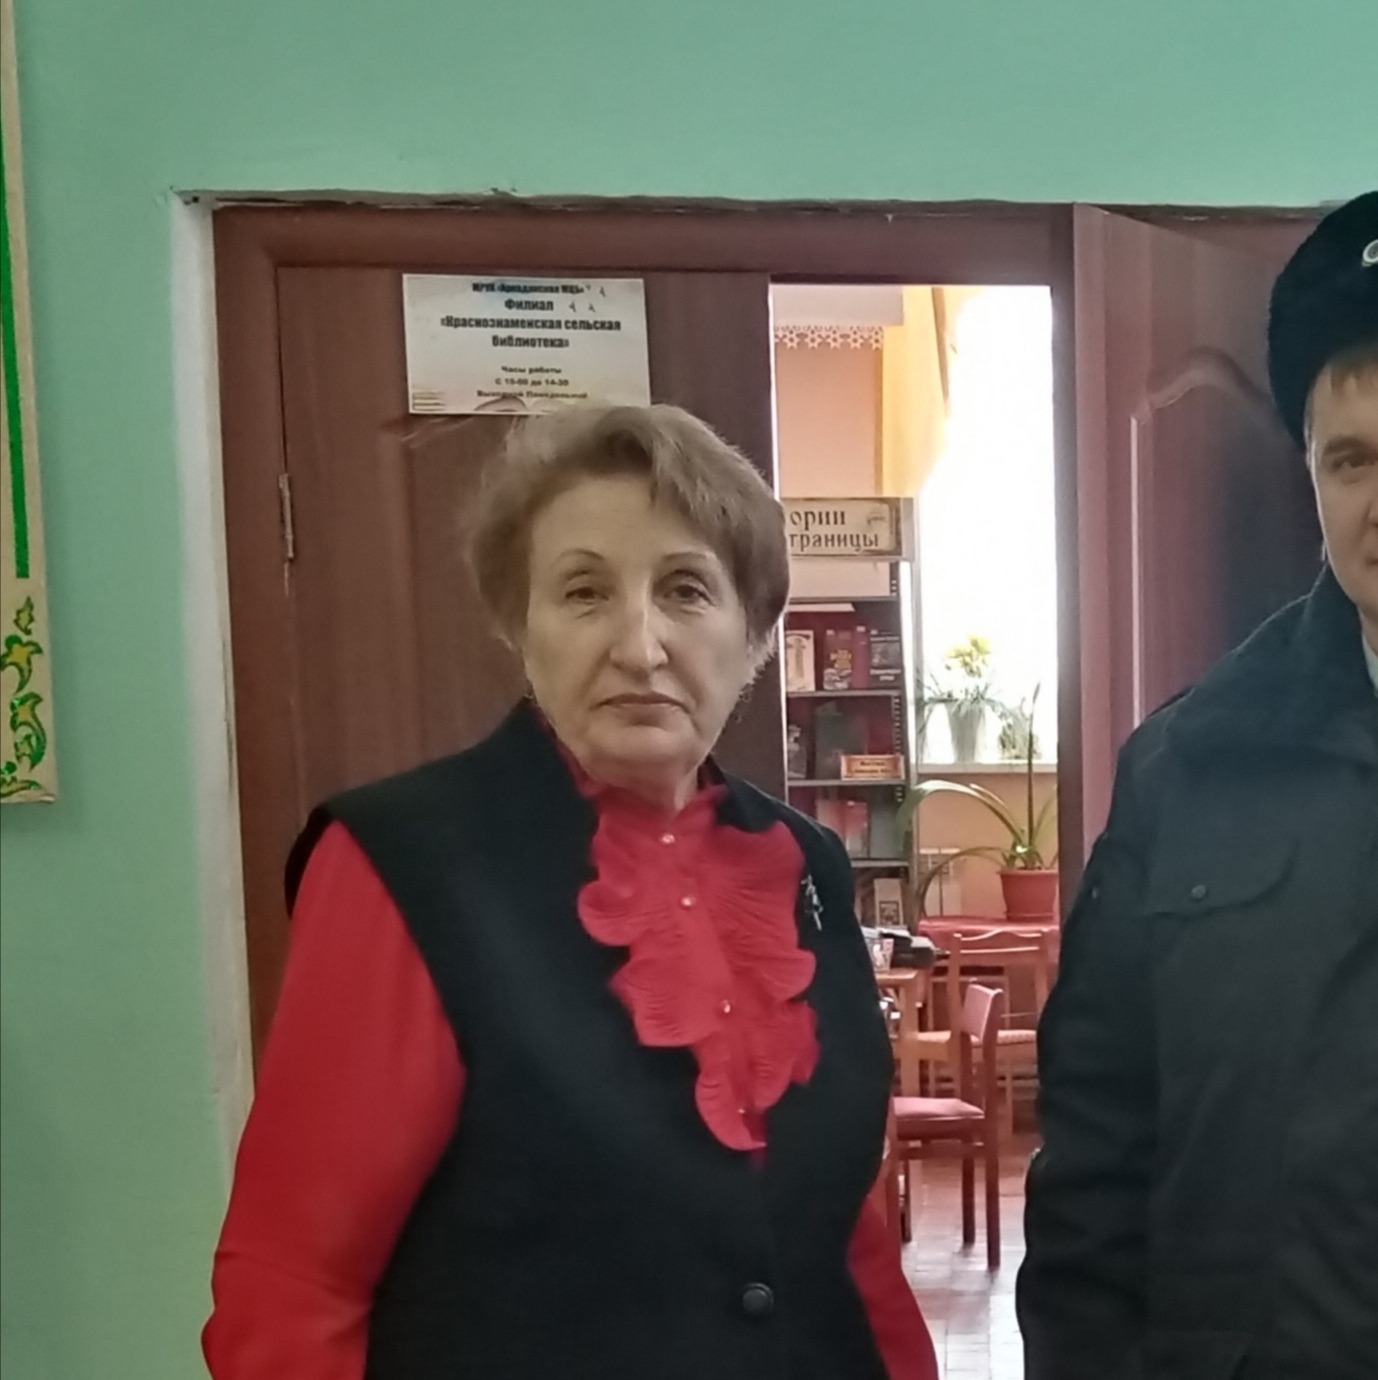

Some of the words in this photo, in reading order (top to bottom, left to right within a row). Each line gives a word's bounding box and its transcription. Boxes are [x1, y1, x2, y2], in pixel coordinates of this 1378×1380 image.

[504, 298, 554, 312] Филиал
[564, 319, 621, 331] сельская
[528, 365, 562, 375] работы
[789, 510, 846, 532] ории
[788, 533, 879, 552] траницы
